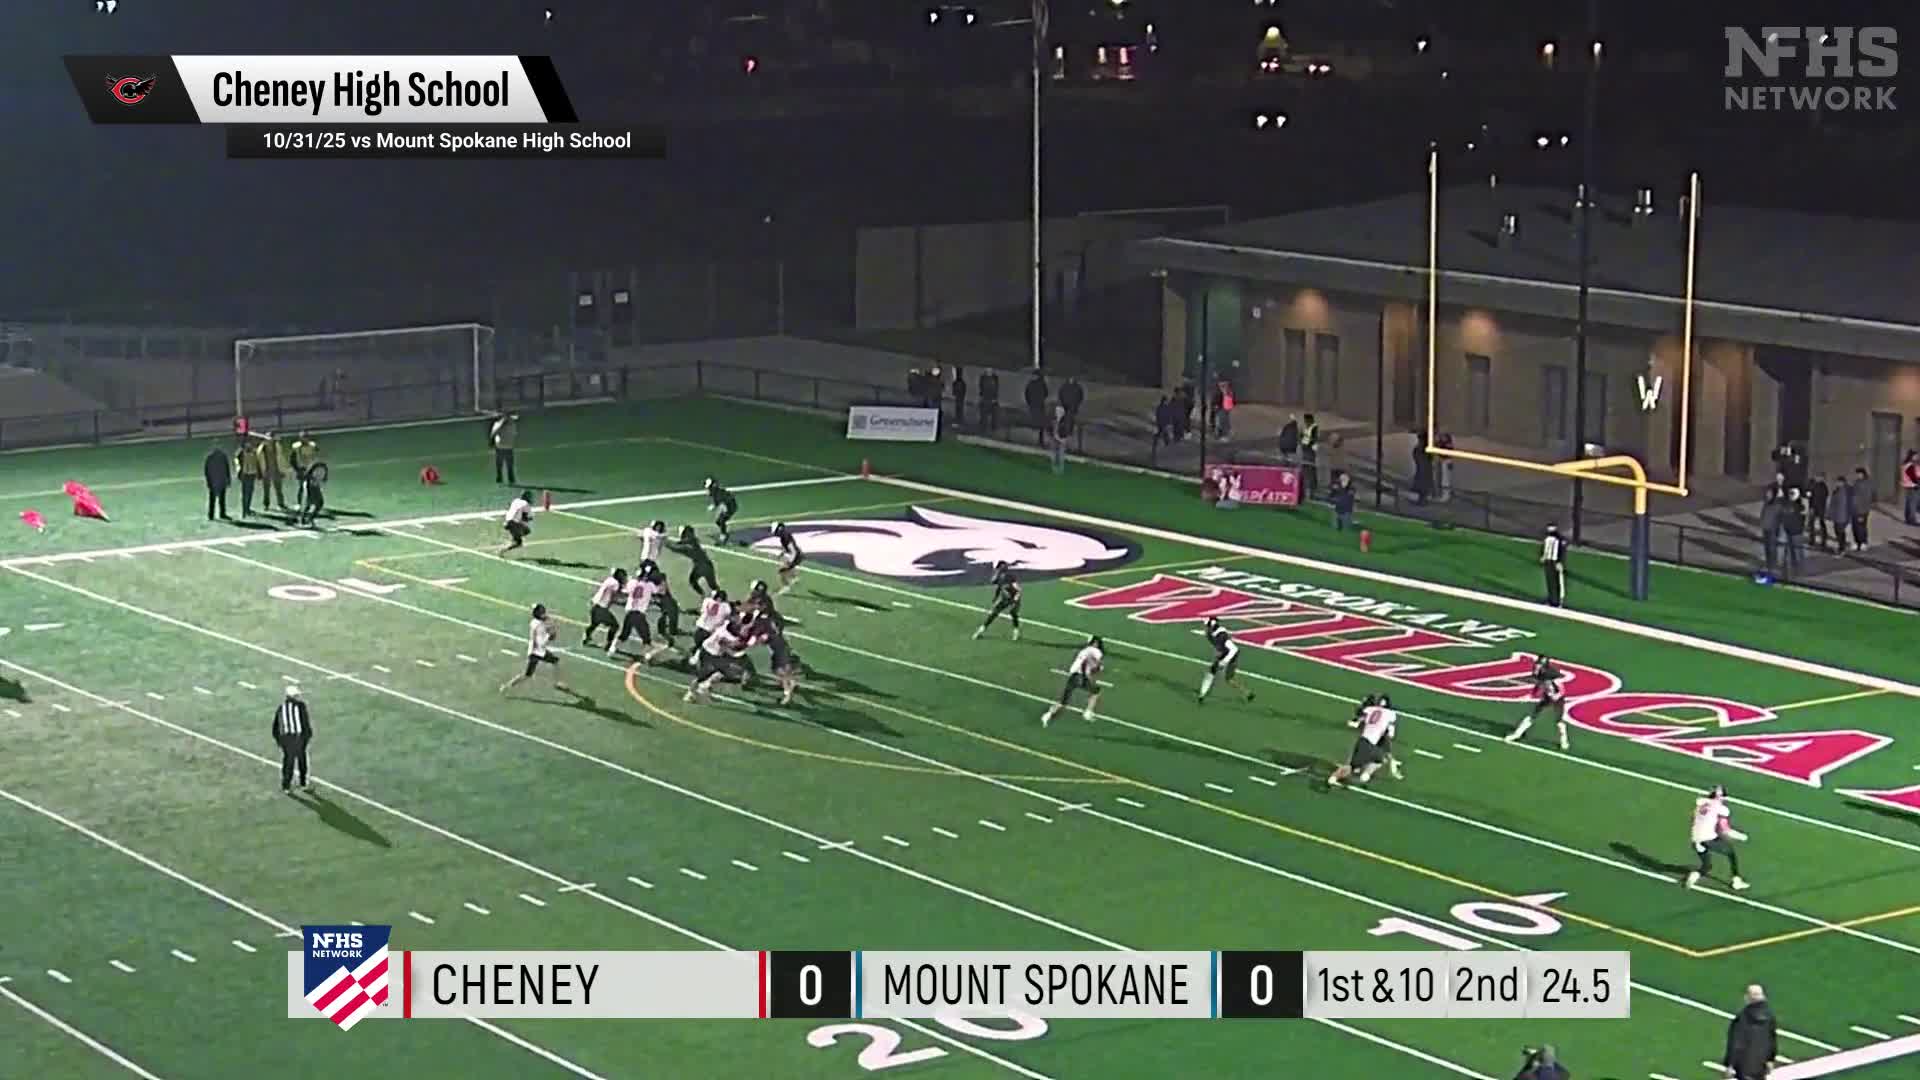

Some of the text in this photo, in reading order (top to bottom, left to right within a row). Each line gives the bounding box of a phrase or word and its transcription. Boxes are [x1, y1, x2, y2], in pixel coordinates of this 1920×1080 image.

[1637, 375, 1663, 411] W
[1259, 582, 1538, 643] SPOKANE
[1066, 573, 1920, 815] WILDCA
[1366, 900, 1563, 951] 10
